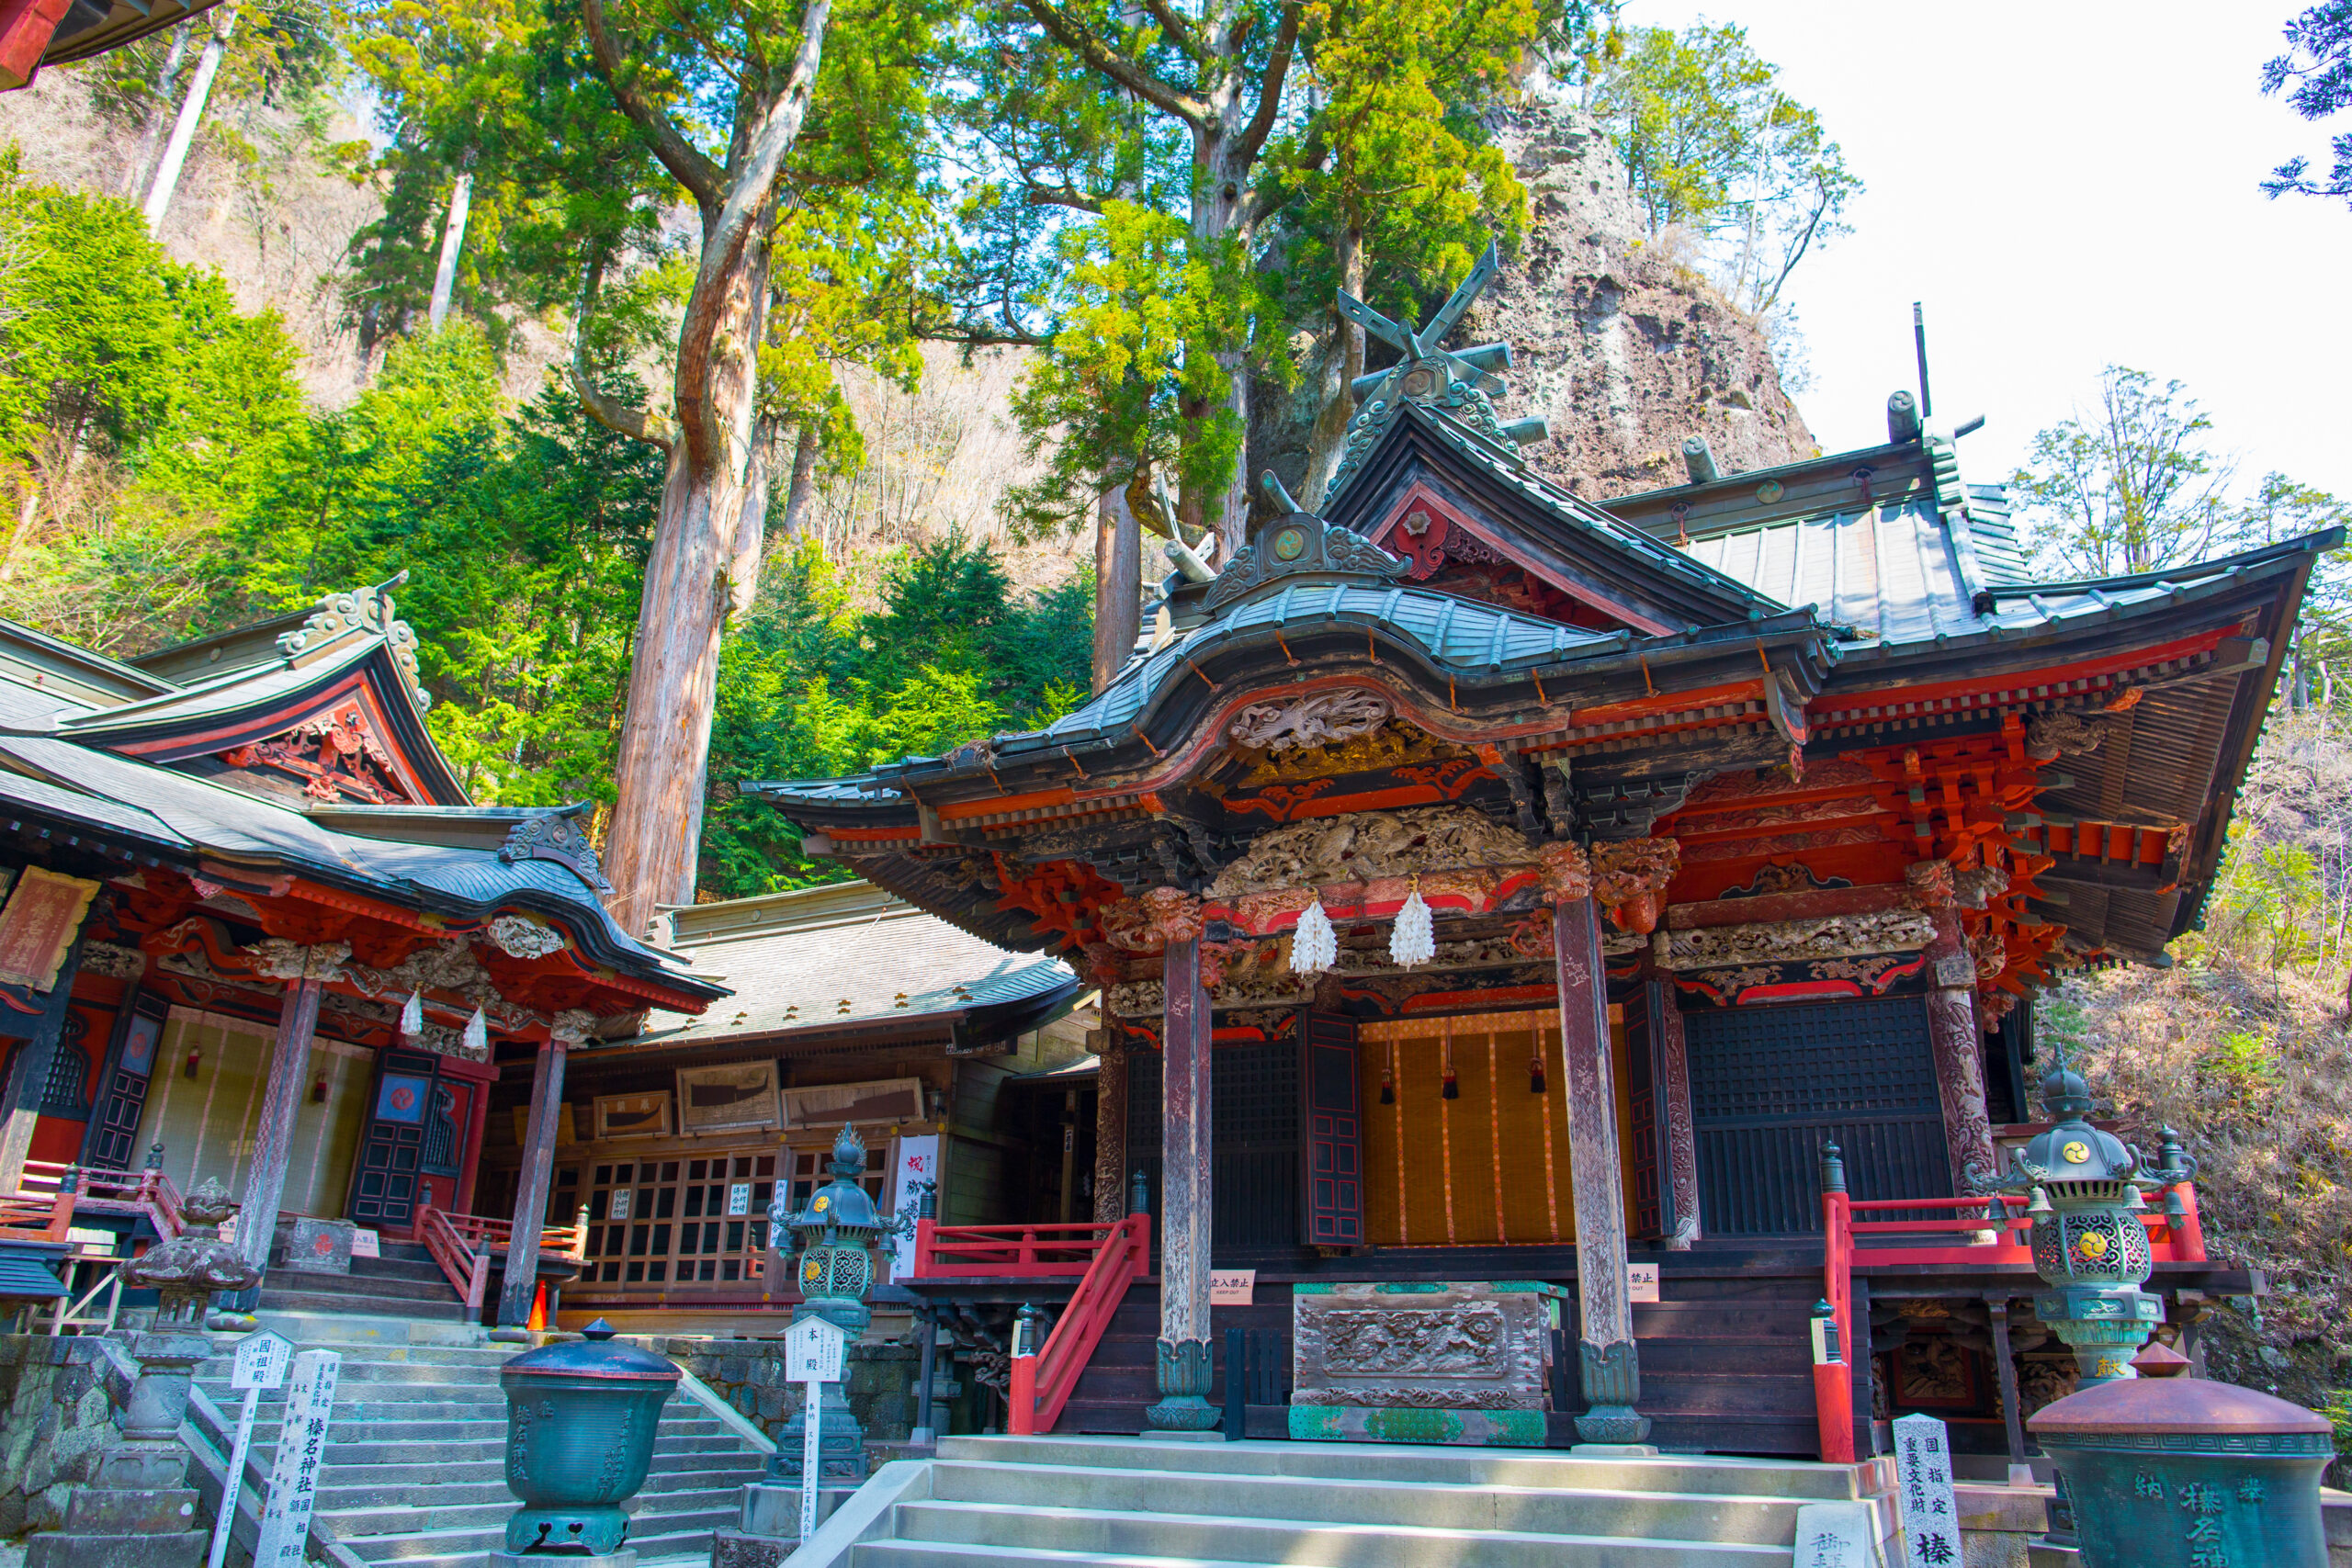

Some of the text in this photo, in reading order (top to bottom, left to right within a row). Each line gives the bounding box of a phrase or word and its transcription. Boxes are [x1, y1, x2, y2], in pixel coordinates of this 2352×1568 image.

[1210, 1278, 1249, 1288] 立入禁止
[1628, 1272, 1654, 1283] 禁止
[253, 1339, 272, 1382] 國祖殿
[806, 1327, 818, 1371] 本殿
[2095, 1355, 2126, 1378] 献
[311, 1363, 325, 1407] 重要文化財
[321, 1362, 336, 1407] 国指定
[808, 1403, 815, 1420] 奉納
[296, 1417, 324, 1495] 榛名神社
[1904, 1437, 1926, 1514] 重要文化財
[1925, 1438, 1948, 1514] 国指定
[803, 1431, 814, 1541] スターテング工業株式会社
[291, 1499, 311, 1557] 国祖社
[1916, 1532, 1955, 1564] 榛
